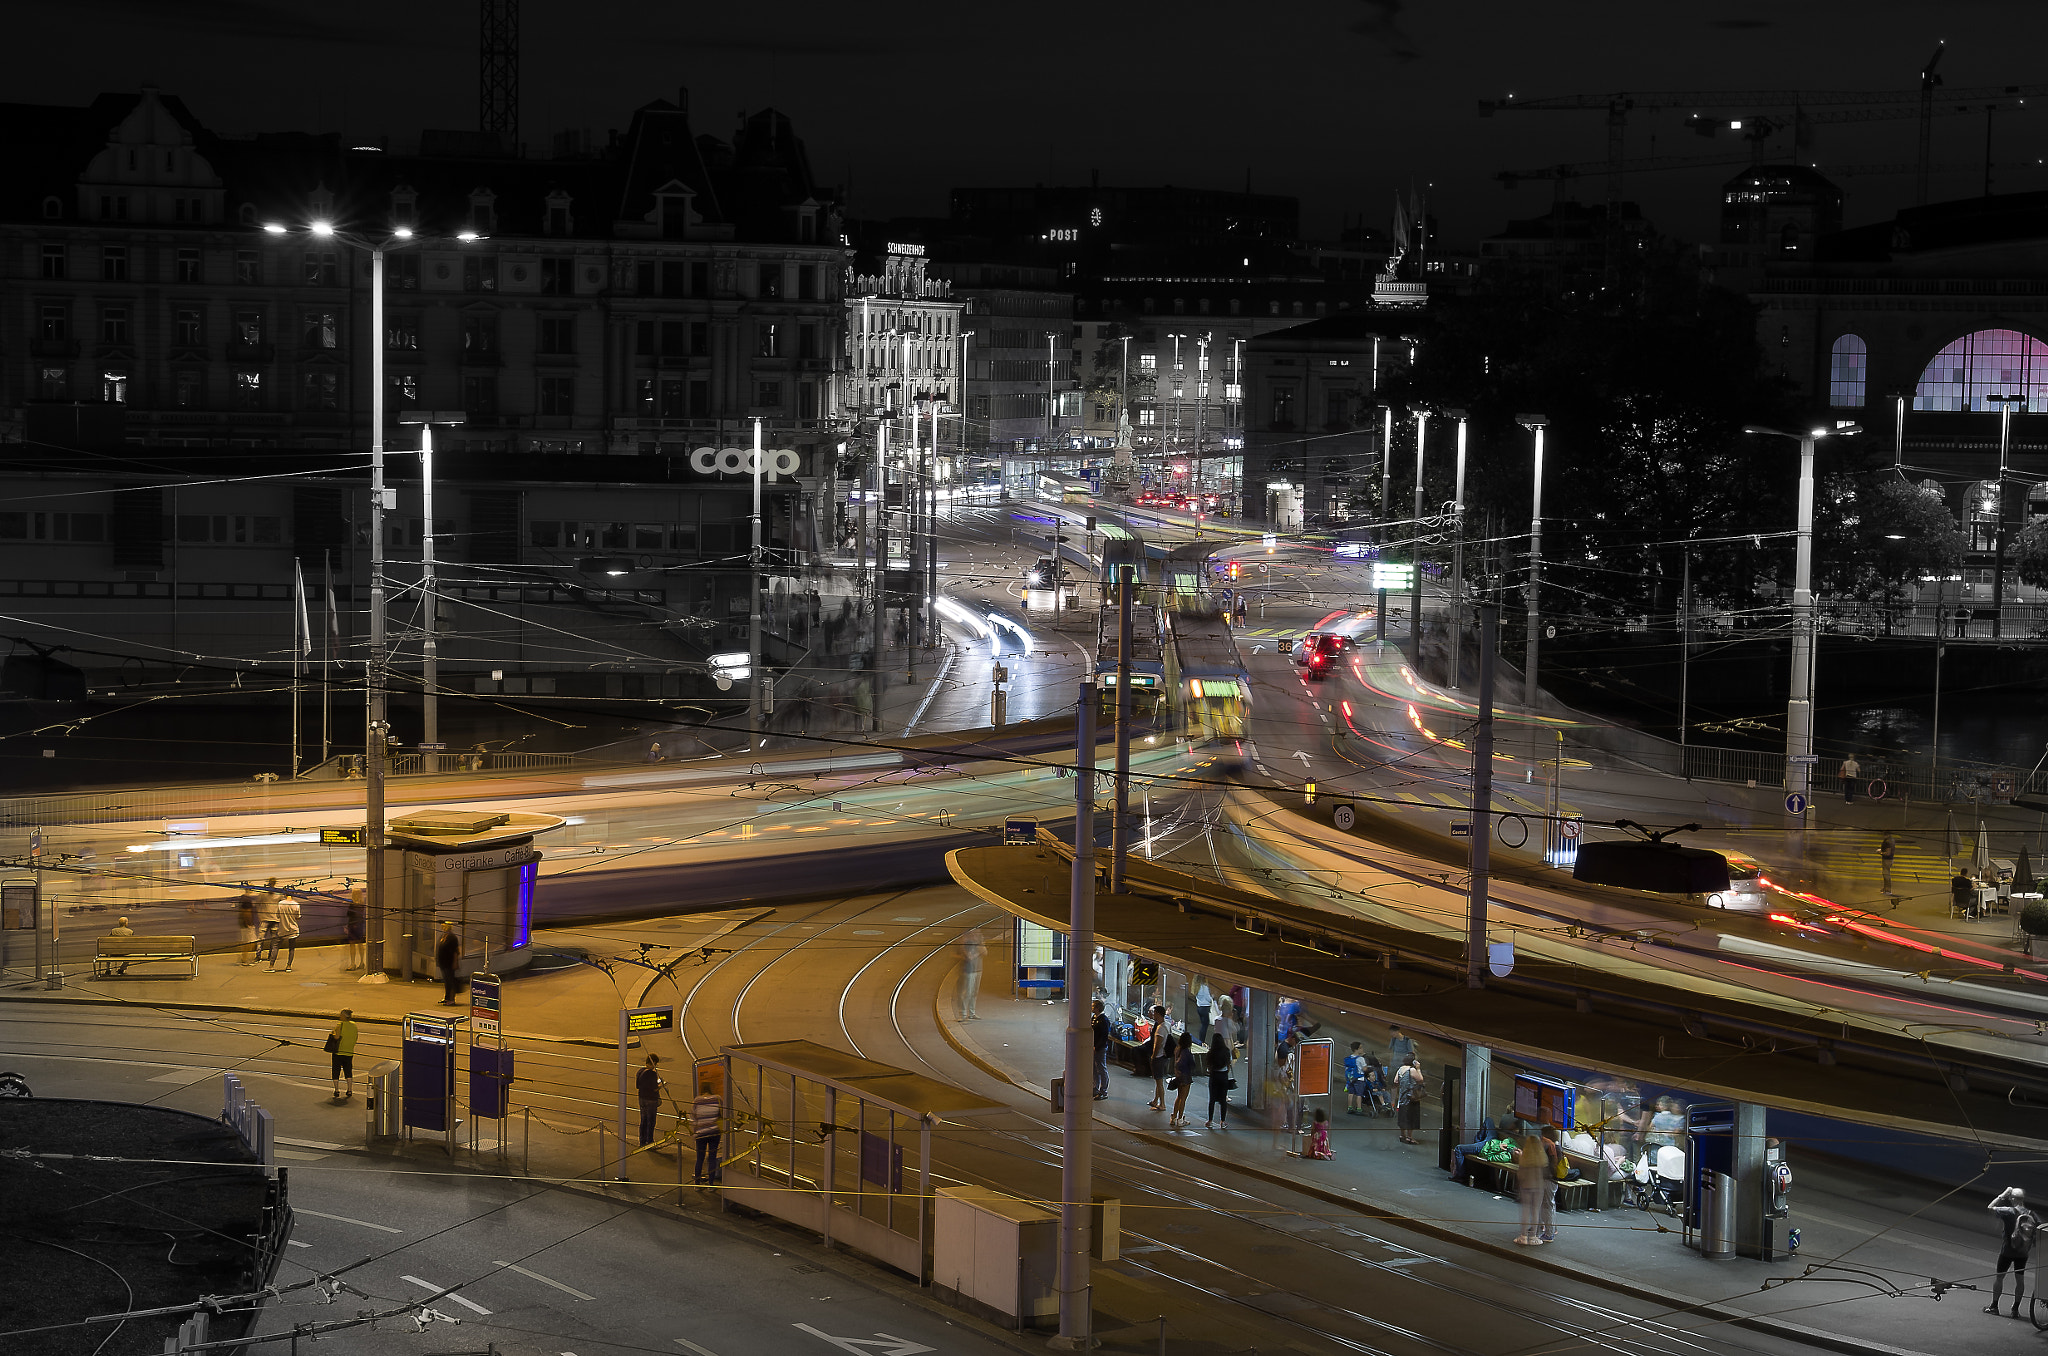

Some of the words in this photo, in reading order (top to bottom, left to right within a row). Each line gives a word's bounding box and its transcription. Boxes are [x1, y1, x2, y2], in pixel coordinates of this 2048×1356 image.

[1050, 229, 1078, 241] POST
[887, 241, 925, 256] SCHWEIZERHOF
[690, 446, 800, 482] coop
[1278, 641, 1292, 652] 36
[1338, 812, 1351, 824] 18
[444, 855, 494, 870] Getränke
